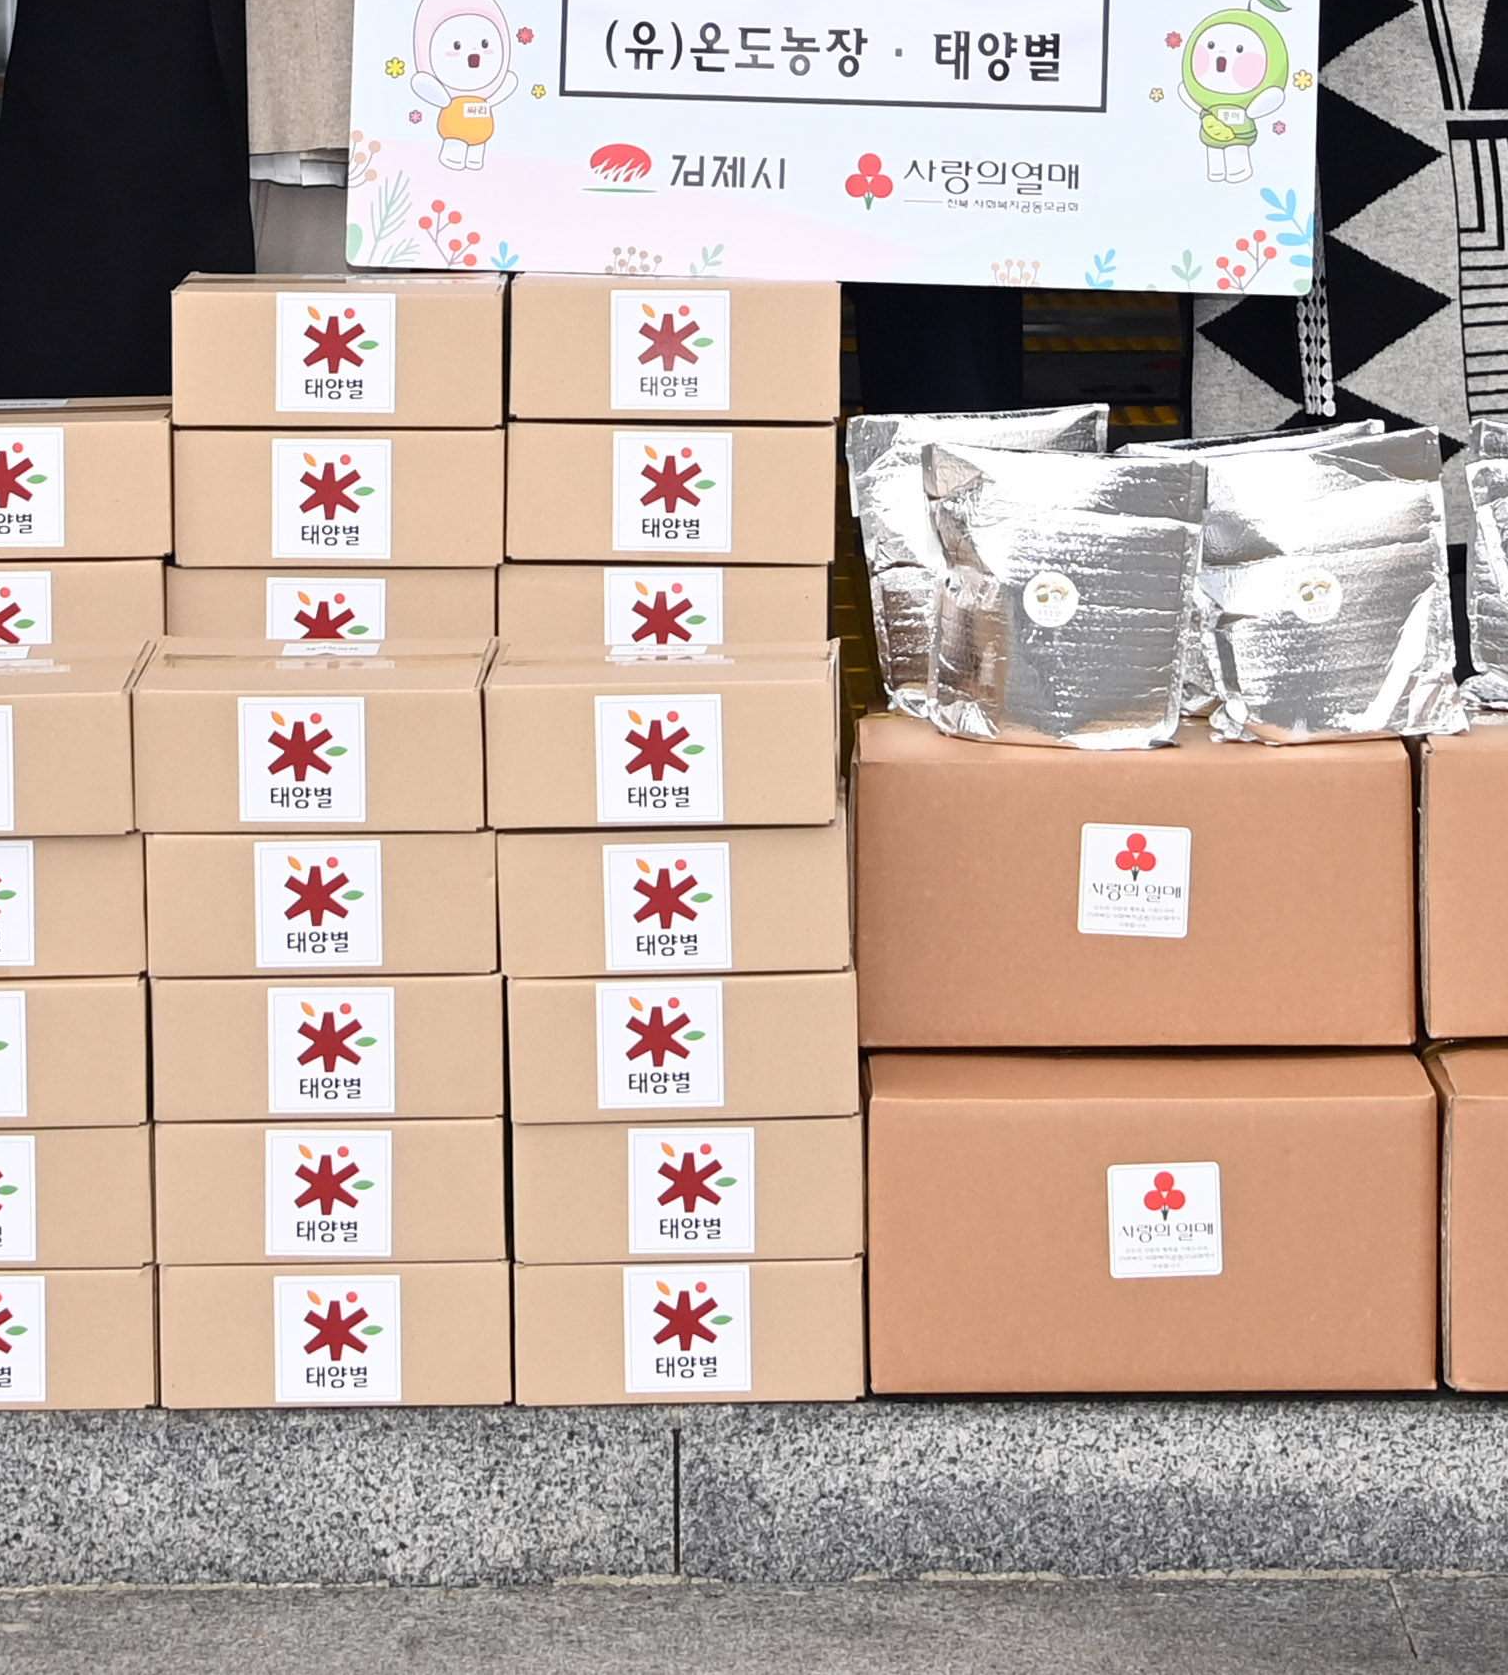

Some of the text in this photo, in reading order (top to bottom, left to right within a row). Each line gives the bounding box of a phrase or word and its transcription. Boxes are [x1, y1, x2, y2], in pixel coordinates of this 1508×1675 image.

[605, 19, 869, 78] (유)온도농장
[933, 30, 1061, 83] 태양별
[670, 154, 786, 190] 김제시
[903, 159, 1080, 196] 사랑의열매
[305, 378, 363, 400] 태양별
[640, 376, 698, 397] 태양별
[301, 524, 359, 546] 태양별
[642, 518, 700, 540] 태양별
[270, 786, 332, 809] 태양별
[627, 786, 690, 809] 태양별
[287, 931, 349, 954] 태양별
[636, 933, 698, 957] 태양별
[299, 1077, 361, 1100] 태양별
[628, 1071, 690, 1095] 태양별
[296, 1220, 358, 1243] 태양별
[659, 1217, 721, 1240] 태양별
[306, 1366, 368, 1389] 태양별
[655, 1356, 717, 1379] 태양별
